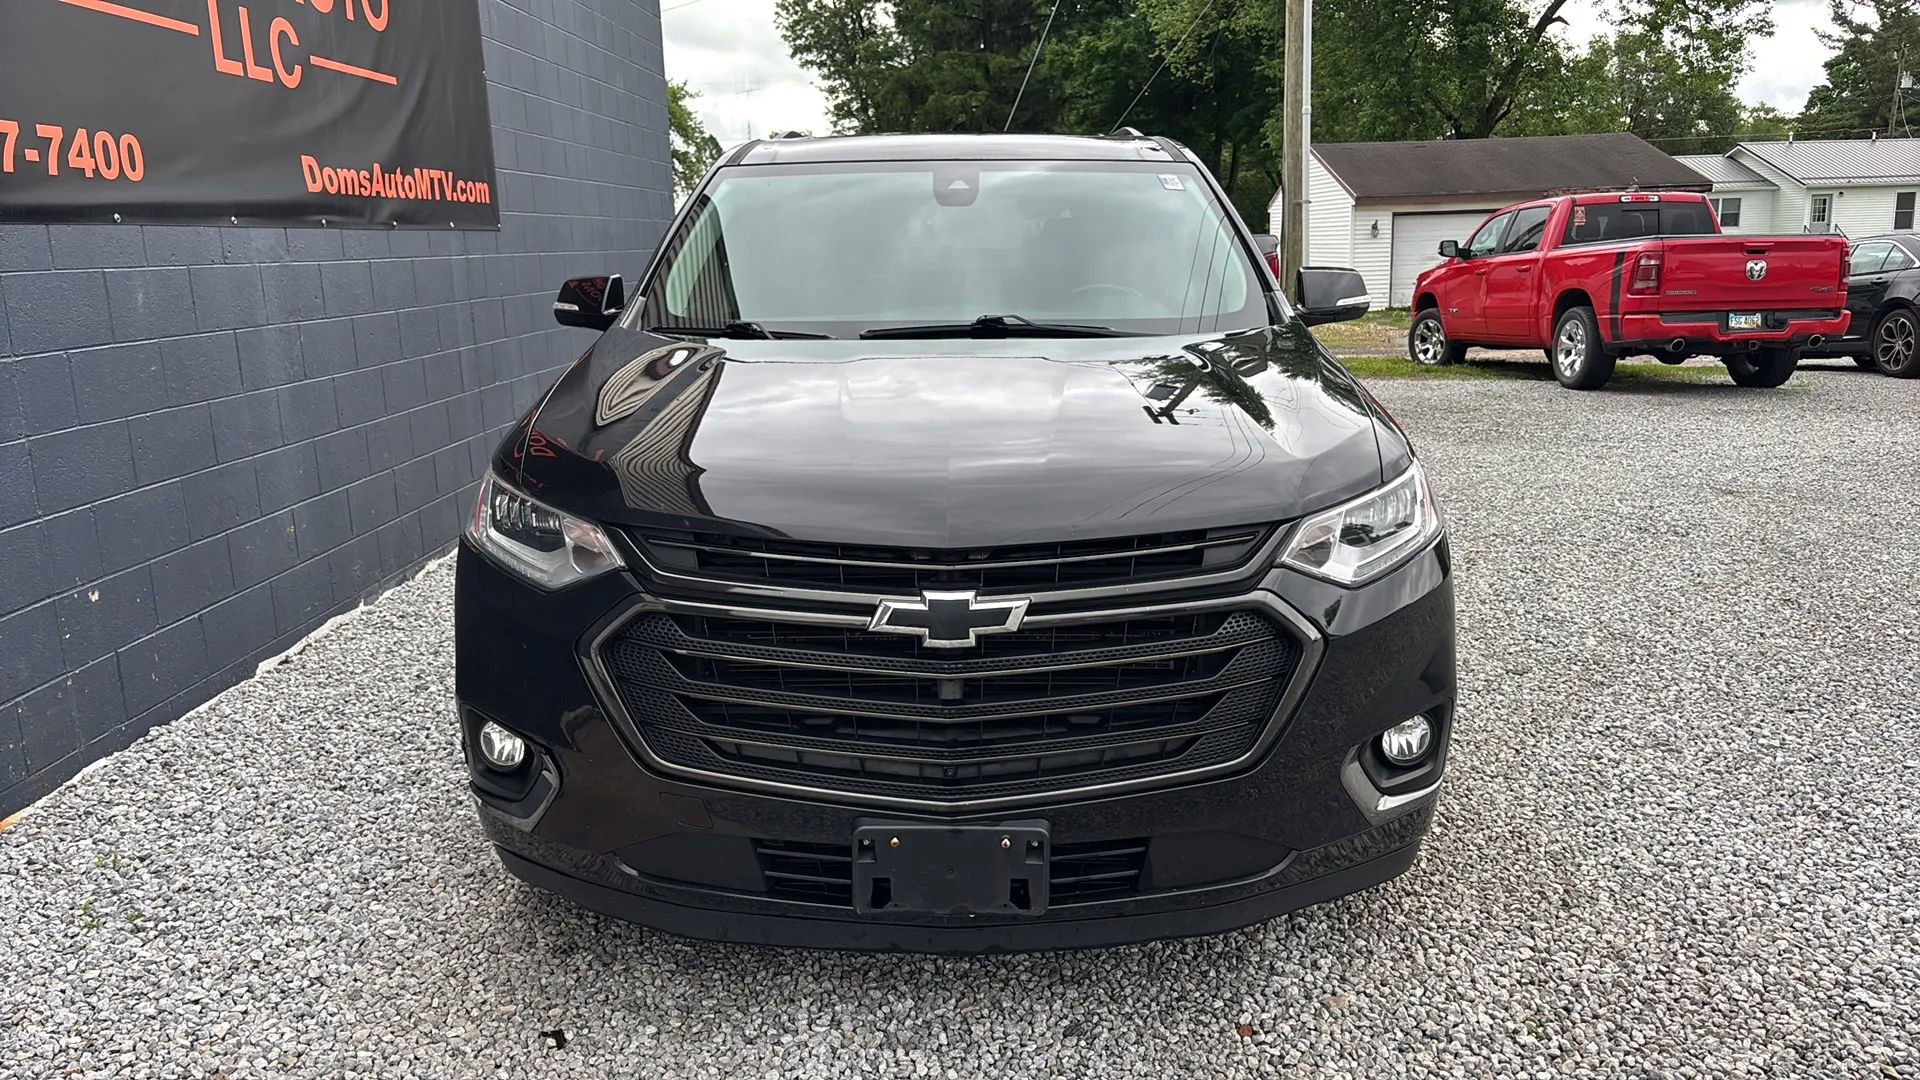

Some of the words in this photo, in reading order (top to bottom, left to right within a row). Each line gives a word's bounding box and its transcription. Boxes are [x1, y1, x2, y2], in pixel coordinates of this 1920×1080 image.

[207, 0, 302, 89] LLC
[0, 119, 145, 182] 7-7400
[300, 154, 490, 204] DomsAutoMTV.com
